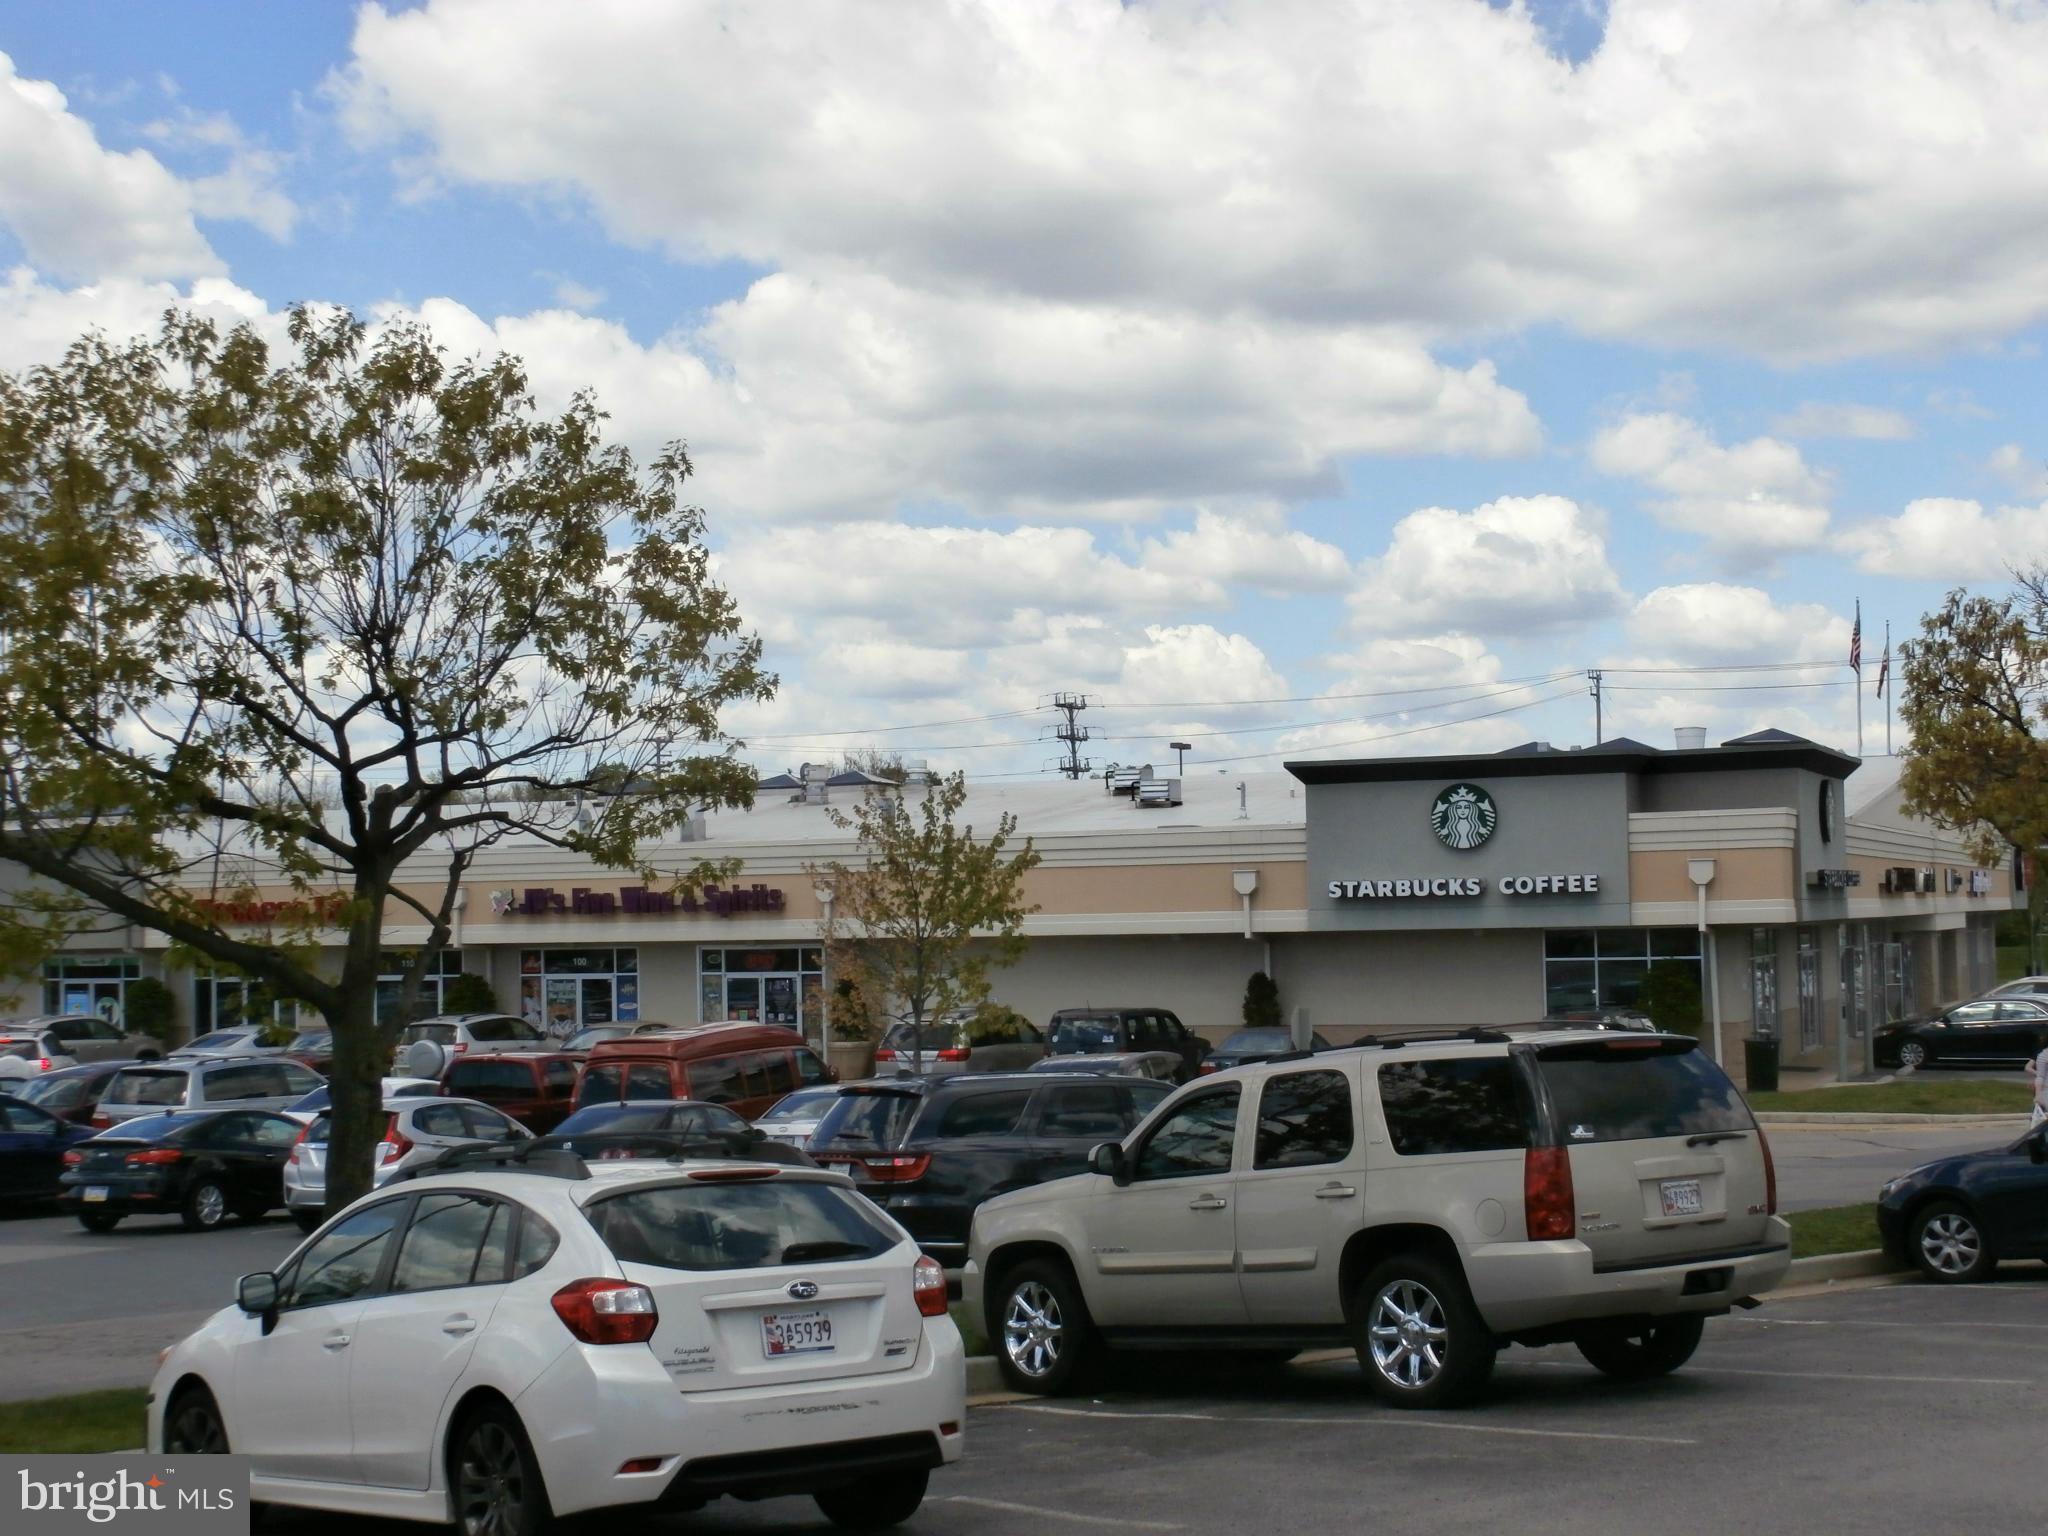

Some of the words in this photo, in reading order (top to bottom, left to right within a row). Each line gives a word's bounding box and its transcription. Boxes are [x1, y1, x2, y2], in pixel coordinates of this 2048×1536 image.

[1328, 878, 1481, 899] STARBUCKS
[1498, 874, 1599, 895] COFFEE
[573, 958, 587, 966] 100
